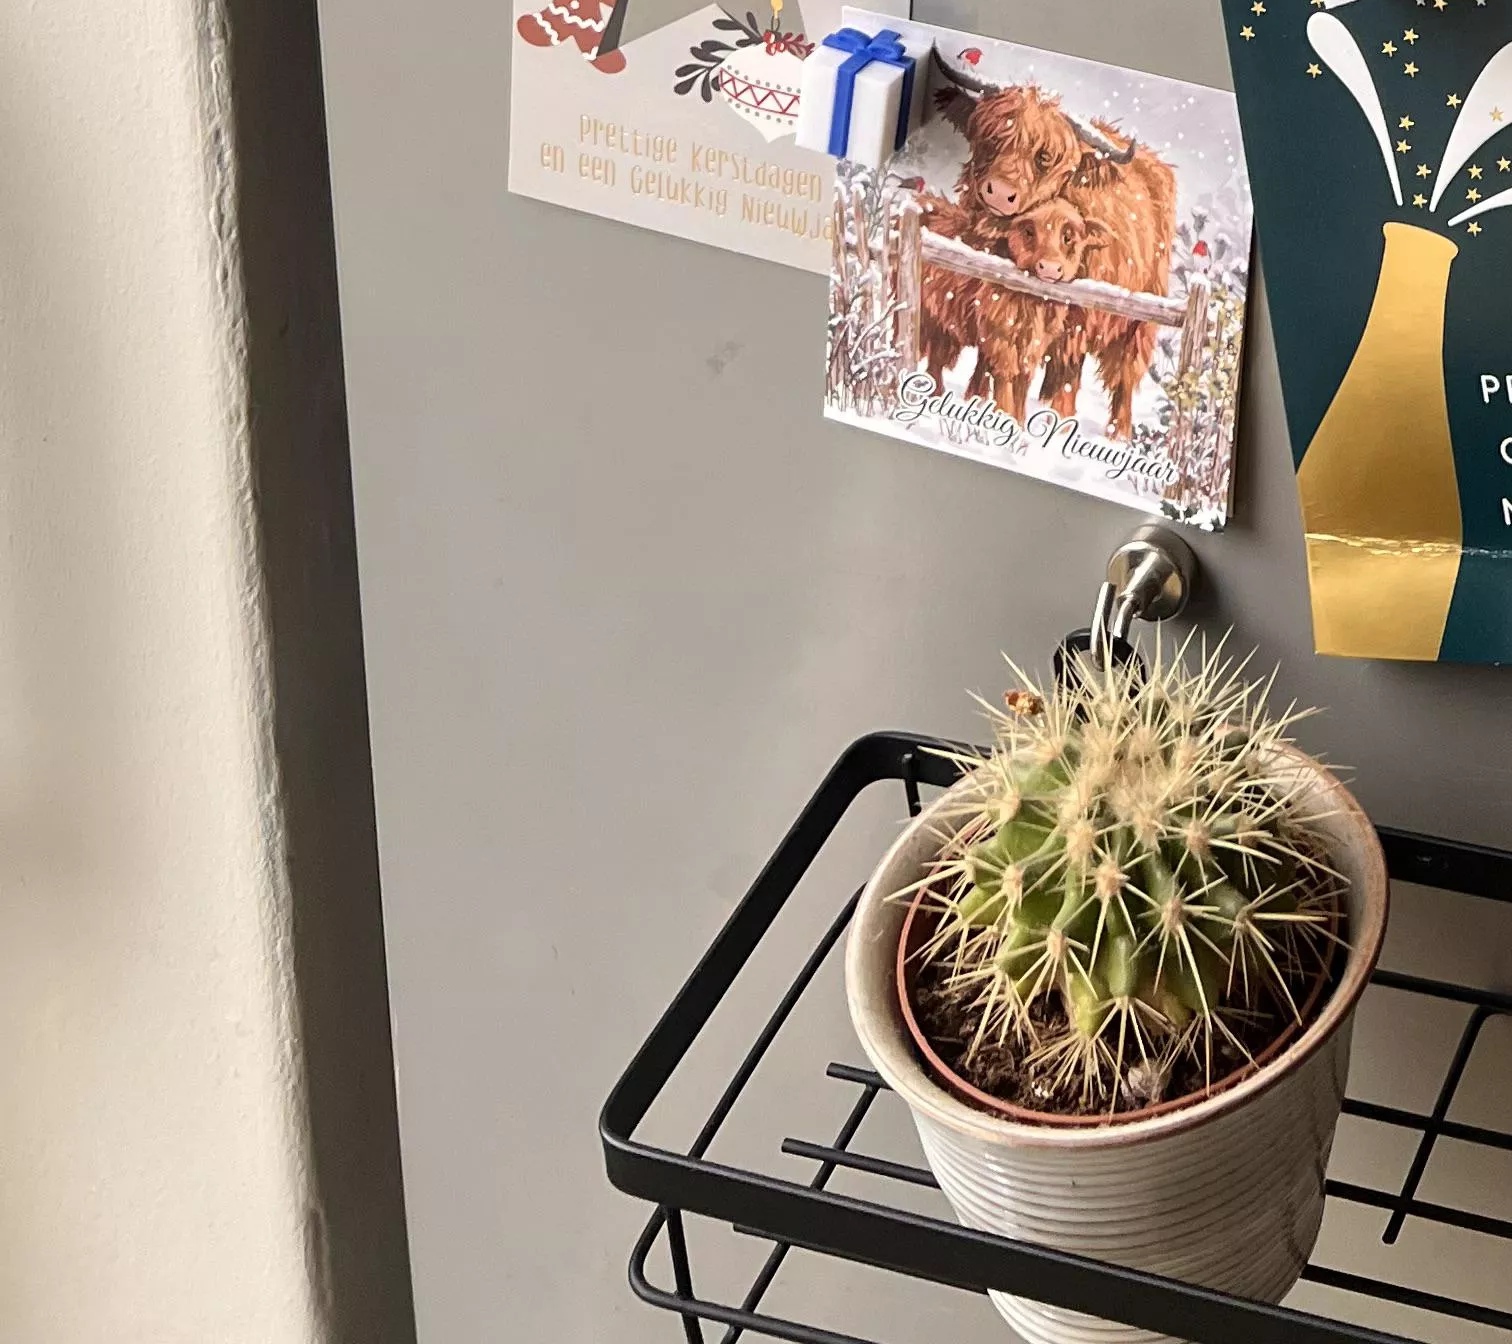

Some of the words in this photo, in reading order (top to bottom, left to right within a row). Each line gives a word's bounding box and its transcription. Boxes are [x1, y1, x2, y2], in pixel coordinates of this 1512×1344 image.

[540, 141, 565, 173] en
[579, 152, 616, 186] een
[741, 192, 834, 241] Nieuwja
[896, 371, 1017, 446] Gelukkig
[1027, 410, 1178, 483] Nieuwjaar
